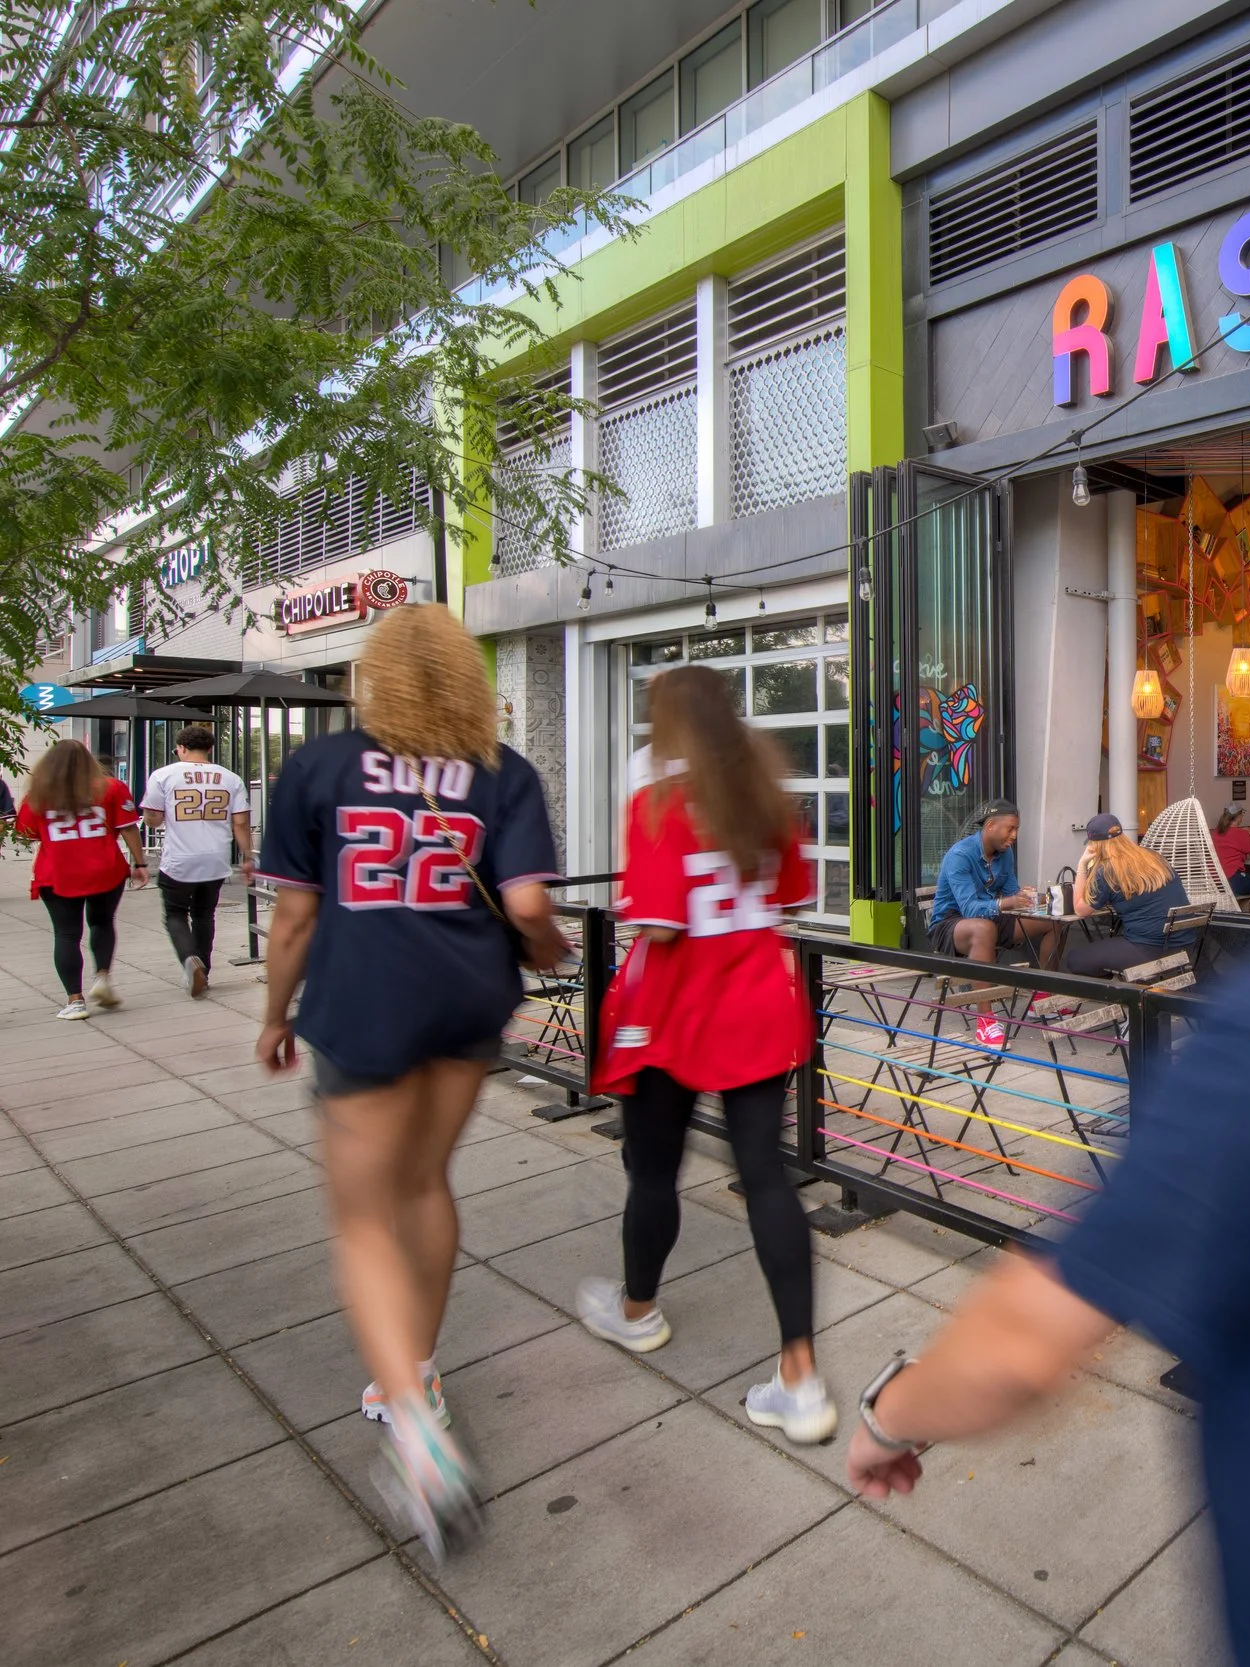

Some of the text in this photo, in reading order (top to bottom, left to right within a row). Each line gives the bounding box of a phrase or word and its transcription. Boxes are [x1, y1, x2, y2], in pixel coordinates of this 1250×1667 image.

[364, 571, 406, 588] CHIPOTLE
[282, 581, 352, 625] CHIPOTLE
[183, 771, 223, 785] SOTO
[361, 750, 476, 801] SOTO
[45, 805, 107, 842] 22
[174, 788, 231, 822] 22
[336, 806, 487, 912] 22
